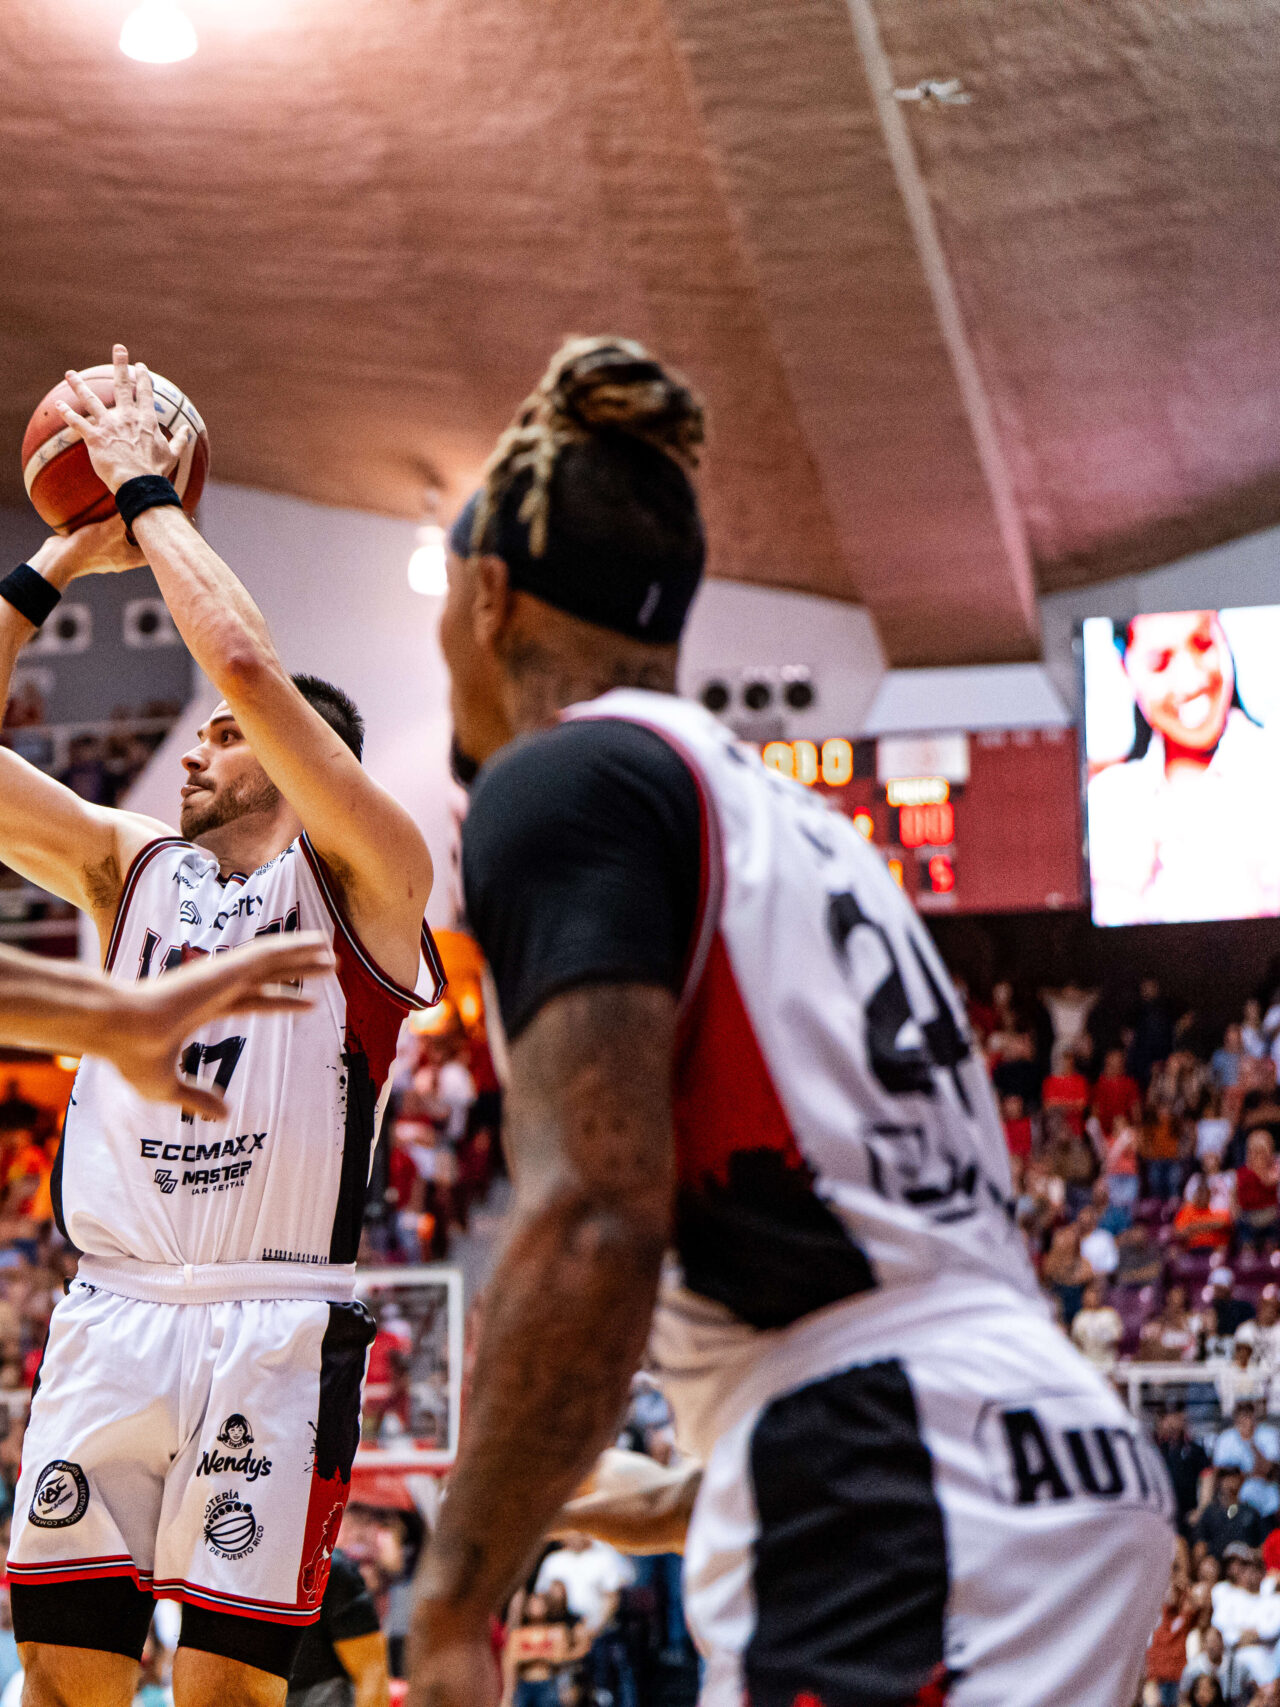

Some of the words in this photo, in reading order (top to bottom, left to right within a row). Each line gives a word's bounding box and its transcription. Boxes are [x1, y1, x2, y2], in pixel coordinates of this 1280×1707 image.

[181, 1159, 253, 1186] MASTER
[209, 1546, 220, 1557] DE
[221, 1546, 255, 1561] PUERTO
[253, 1525, 265, 1548] RICO
